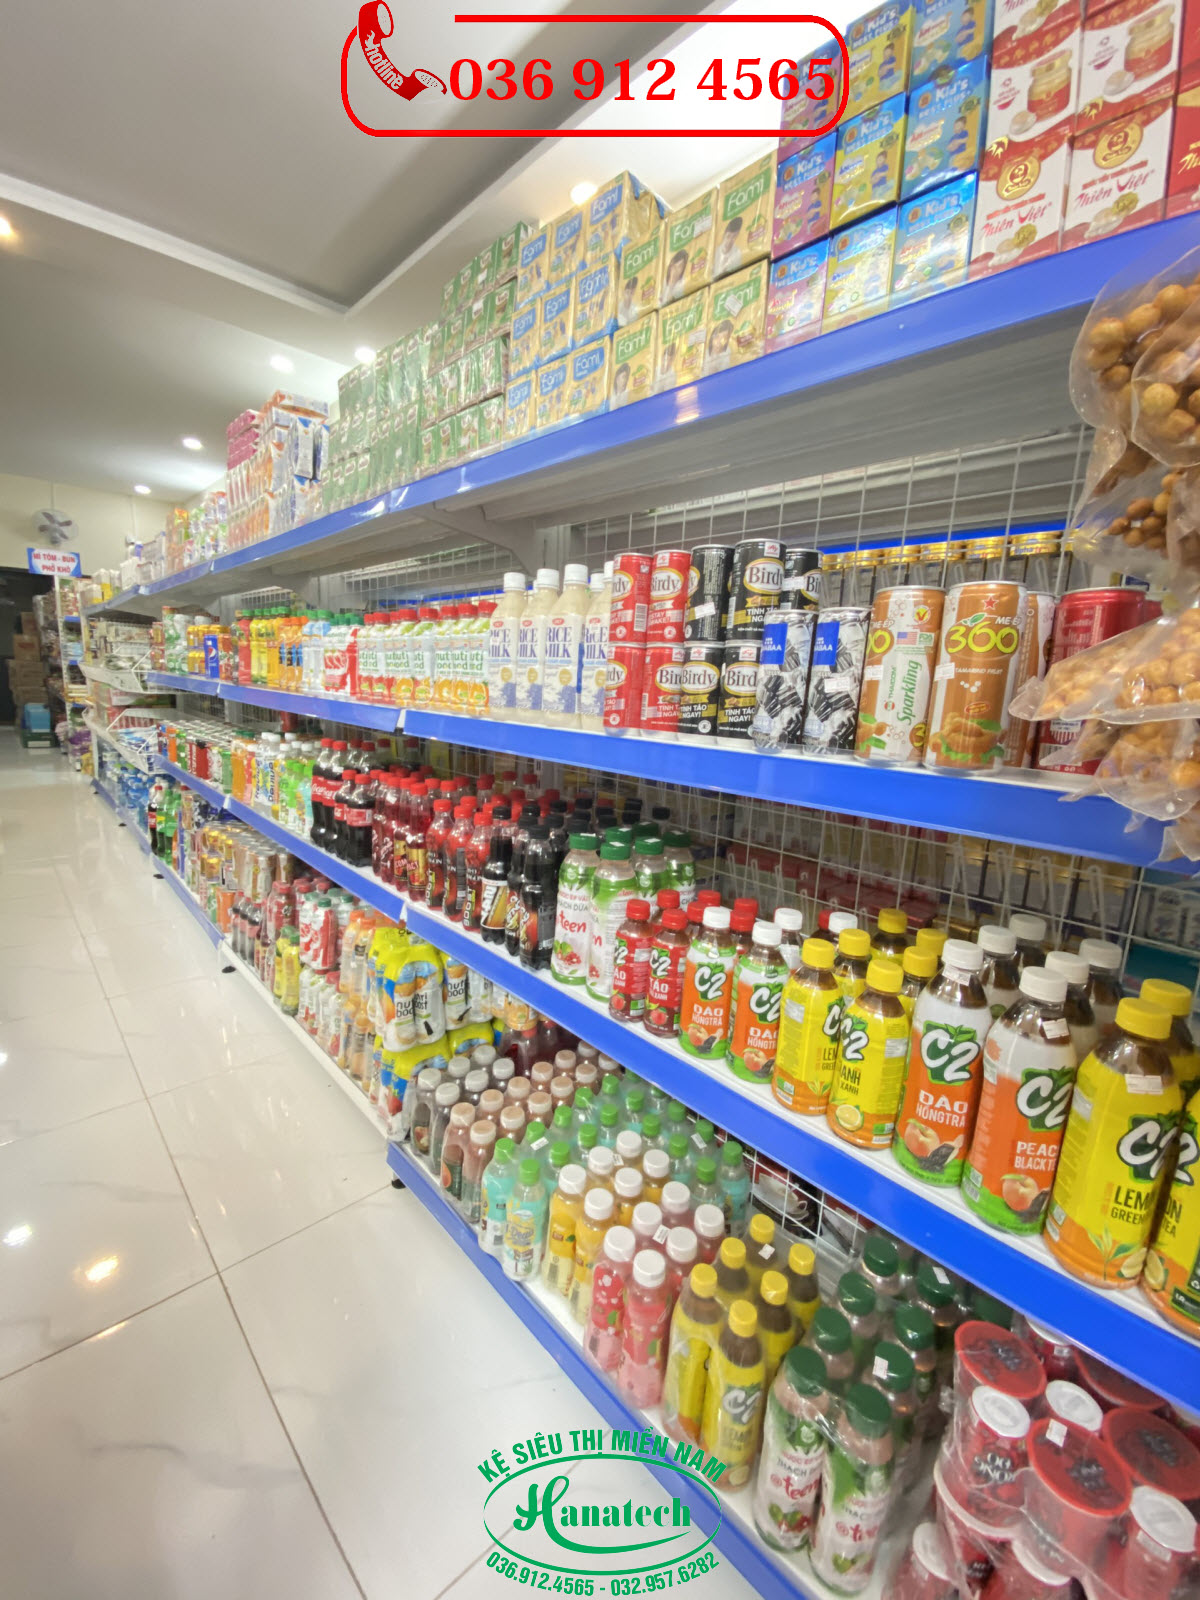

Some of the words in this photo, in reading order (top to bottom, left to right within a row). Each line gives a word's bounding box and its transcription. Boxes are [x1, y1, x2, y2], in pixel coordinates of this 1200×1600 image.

[727, 175, 764, 213] Fami
[626, 244, 655, 268] Fami
[716, 286, 754, 311] Fmi
[618, 333, 647, 355] Fami
[947, 621, 1019, 654] 360
[727, 670, 758, 687] Bird
[896, 660, 923, 726] Sparkling
[559, 910, 587, 933] teen
[650, 949, 672, 976] C2
[694, 965, 727, 1000] C2
[749, 986, 782, 1022] C2
[823, 1004, 841, 1036] C
[921, 1028, 980, 1082] C2
[918, 1089, 968, 1114] ĐÀO
[1016, 1075, 1072, 1129] C2
[1016, 1141, 1059, 1158] PEAC
